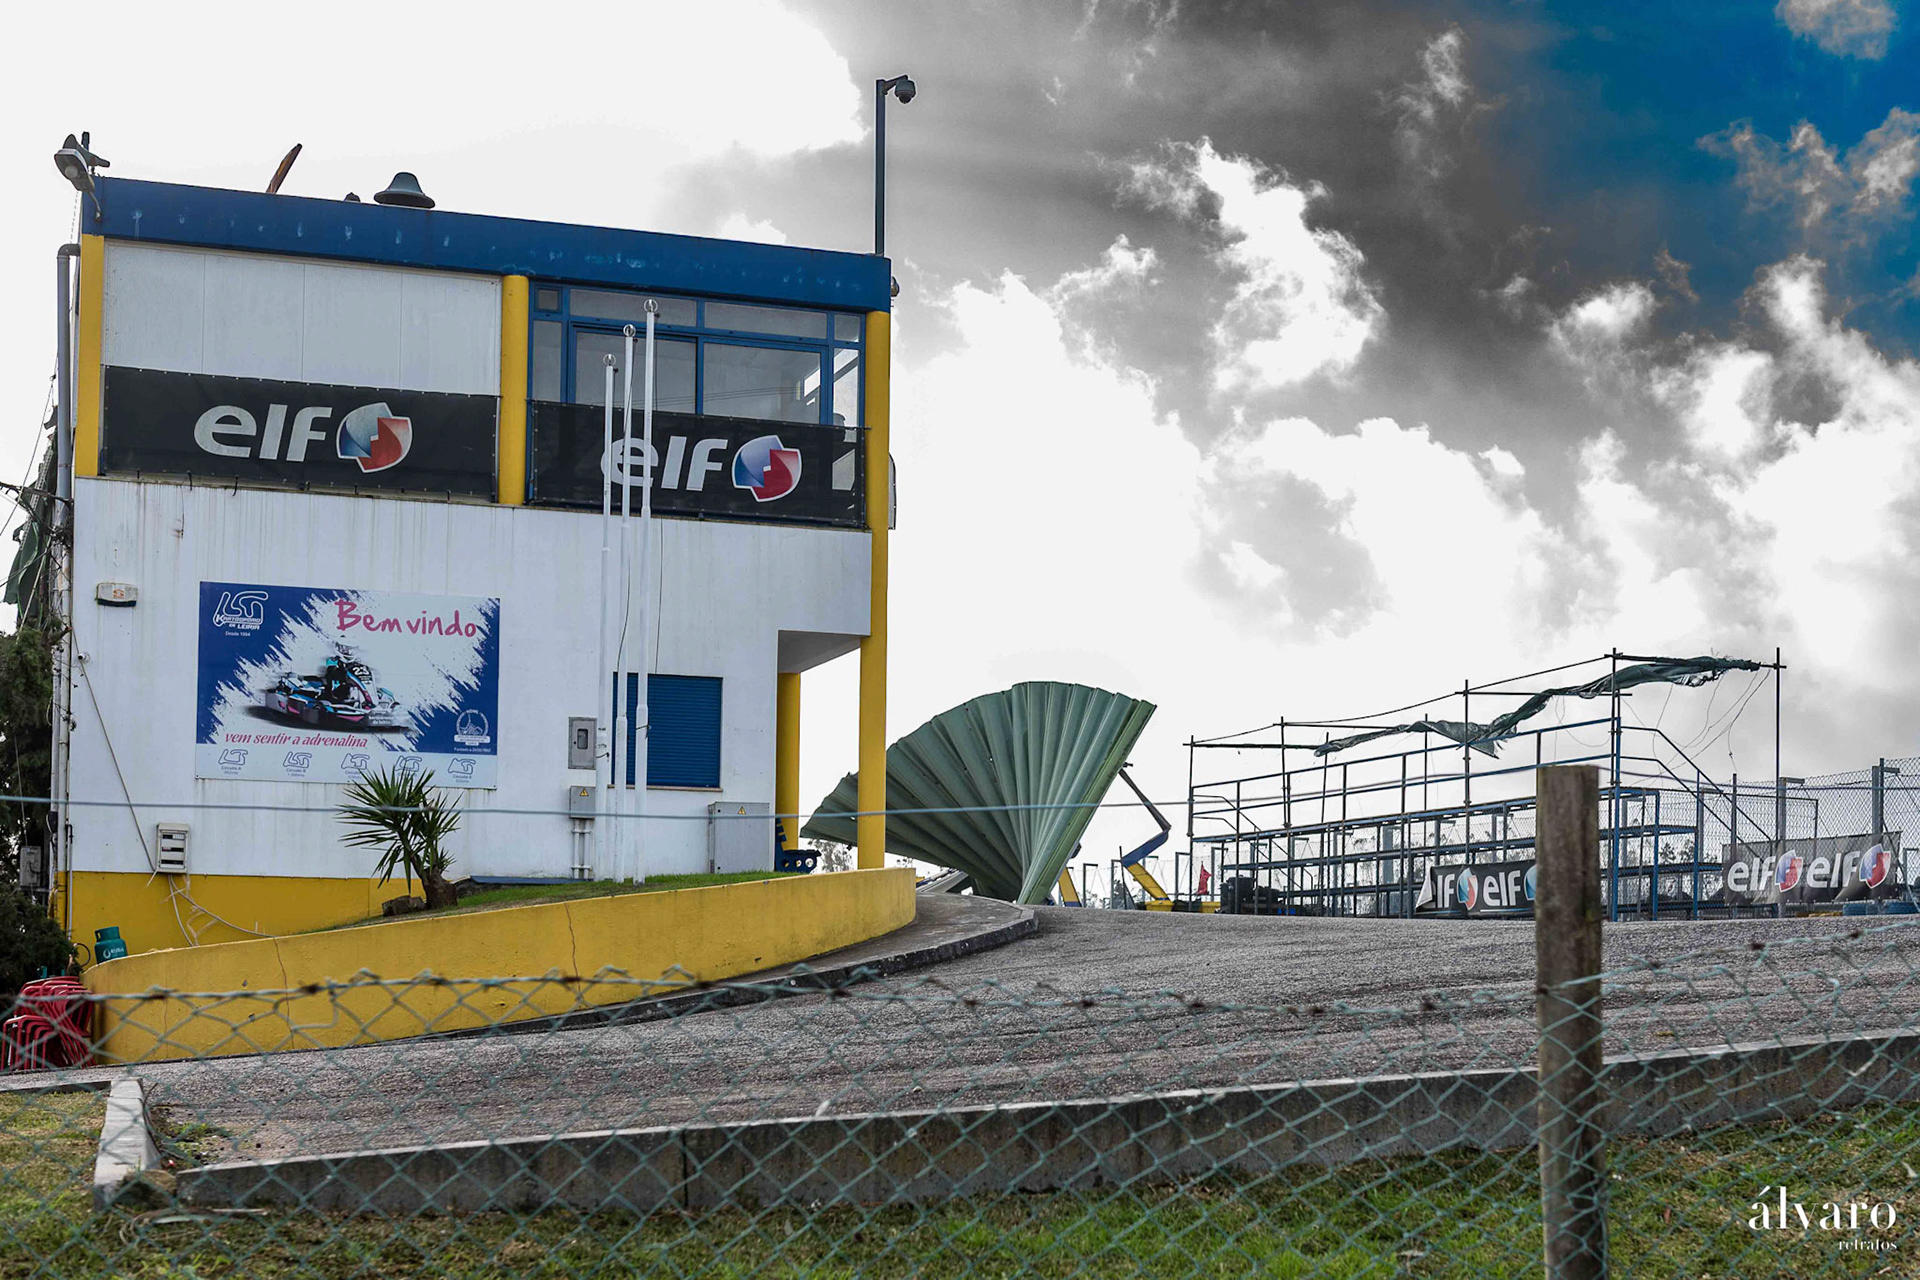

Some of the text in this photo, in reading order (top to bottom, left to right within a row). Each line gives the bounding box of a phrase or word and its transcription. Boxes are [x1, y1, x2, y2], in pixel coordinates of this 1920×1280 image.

[193, 403, 333, 462] elf
[600, 435, 728, 492] elf
[225, 732, 368, 748] vem sentir a adrenalina
[1727, 854, 1776, 892] elf
[1806, 850, 1861, 888] elf
[1483, 870, 1521, 907] elf
